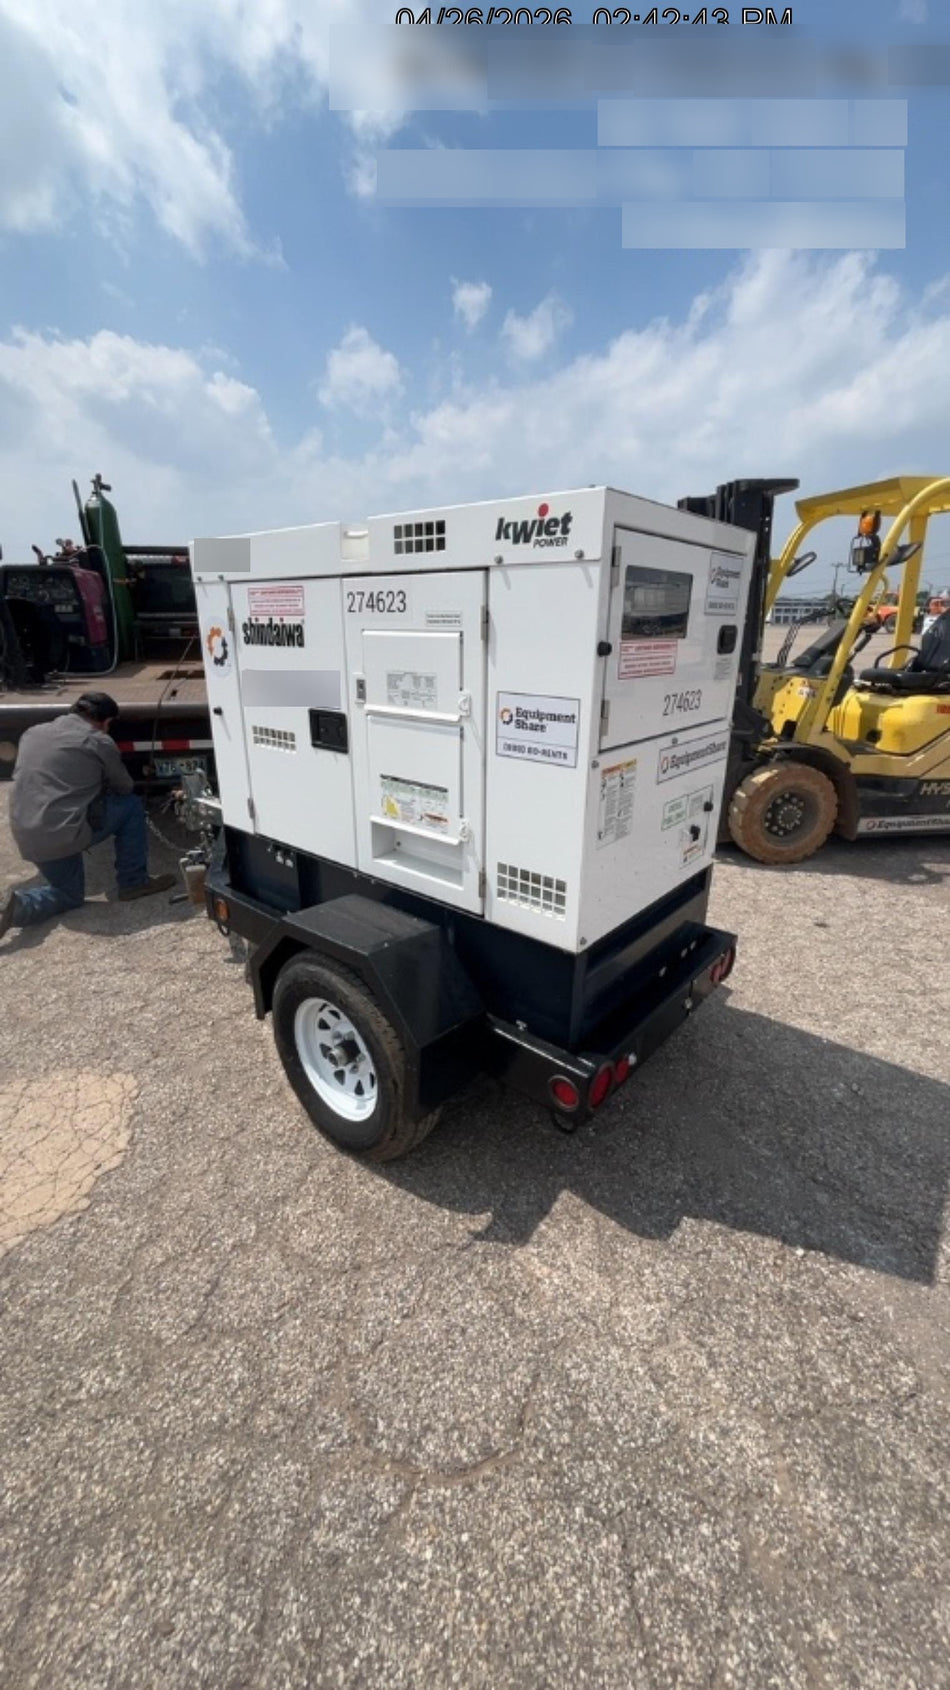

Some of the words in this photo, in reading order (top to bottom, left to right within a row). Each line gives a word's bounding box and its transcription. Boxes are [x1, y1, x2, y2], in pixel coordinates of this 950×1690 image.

[495, 503, 573, 545] kwiet
[533, 536, 568, 548] POWER
[347, 590, 406, 613] 274623
[242, 617, 305, 648] shindaiwa
[662, 689, 703, 716] 274623
[514, 719, 547, 733] Share
[515, 706, 576, 724] Equipment
